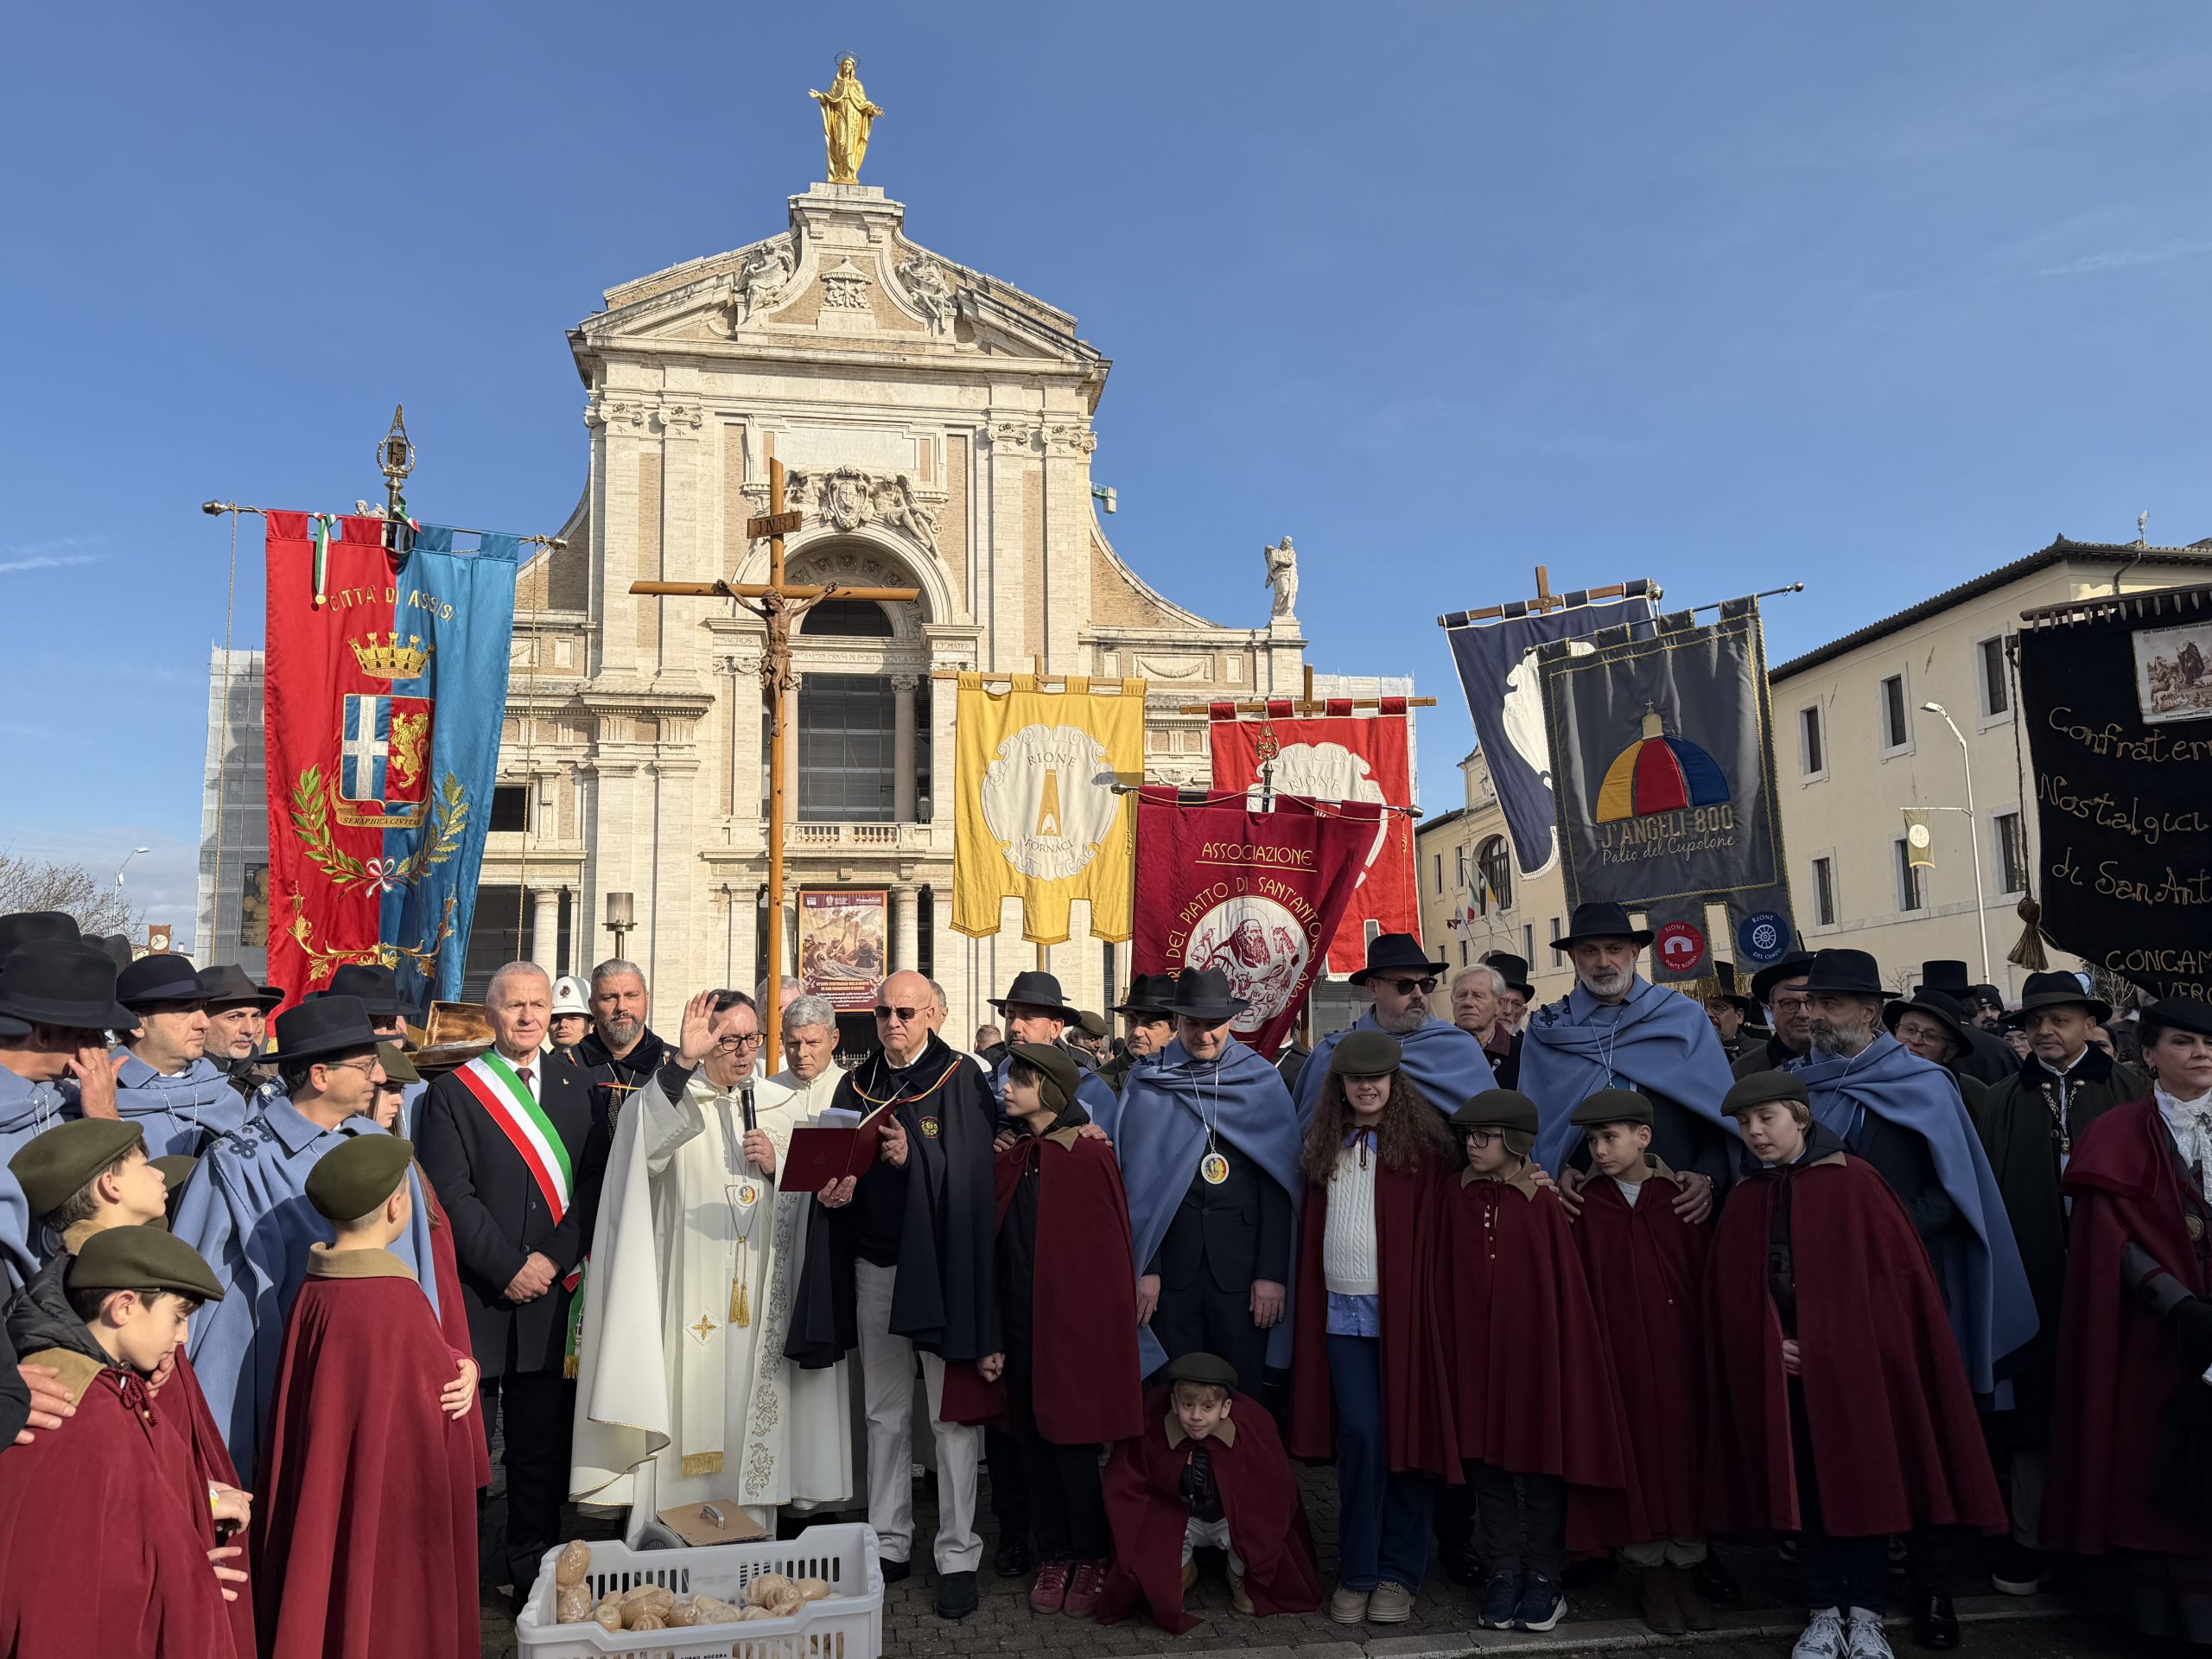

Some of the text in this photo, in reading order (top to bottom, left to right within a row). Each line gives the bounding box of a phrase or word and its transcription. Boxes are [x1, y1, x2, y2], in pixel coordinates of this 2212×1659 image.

[385, 587, 400, 605] DI
[408, 589, 456, 622] ASSISI
[1027, 752, 1077, 768] RIONE
[1287, 775, 1340, 791] RIONE
[2038, 772, 2210, 844] Nostalgici
[343, 817, 422, 826] SERAPHICA CIVITAS
[1694, 804, 1734, 833] 800
[1025, 838, 1074, 854] FORNACI
[1201, 842, 1313, 866] ASSOCIAZIONE
[1602, 830, 1736, 866] Palio del Cupolone
[1166, 930, 1188, 958] DEL
[1179, 882, 1229, 925] PIATTO
[1236, 876, 1249, 893] DI
[1751, 914, 1775, 924] RIONE
[1665, 925, 1686, 933] RIONE
[1752, 947, 1783, 960] DEL CAMPO
